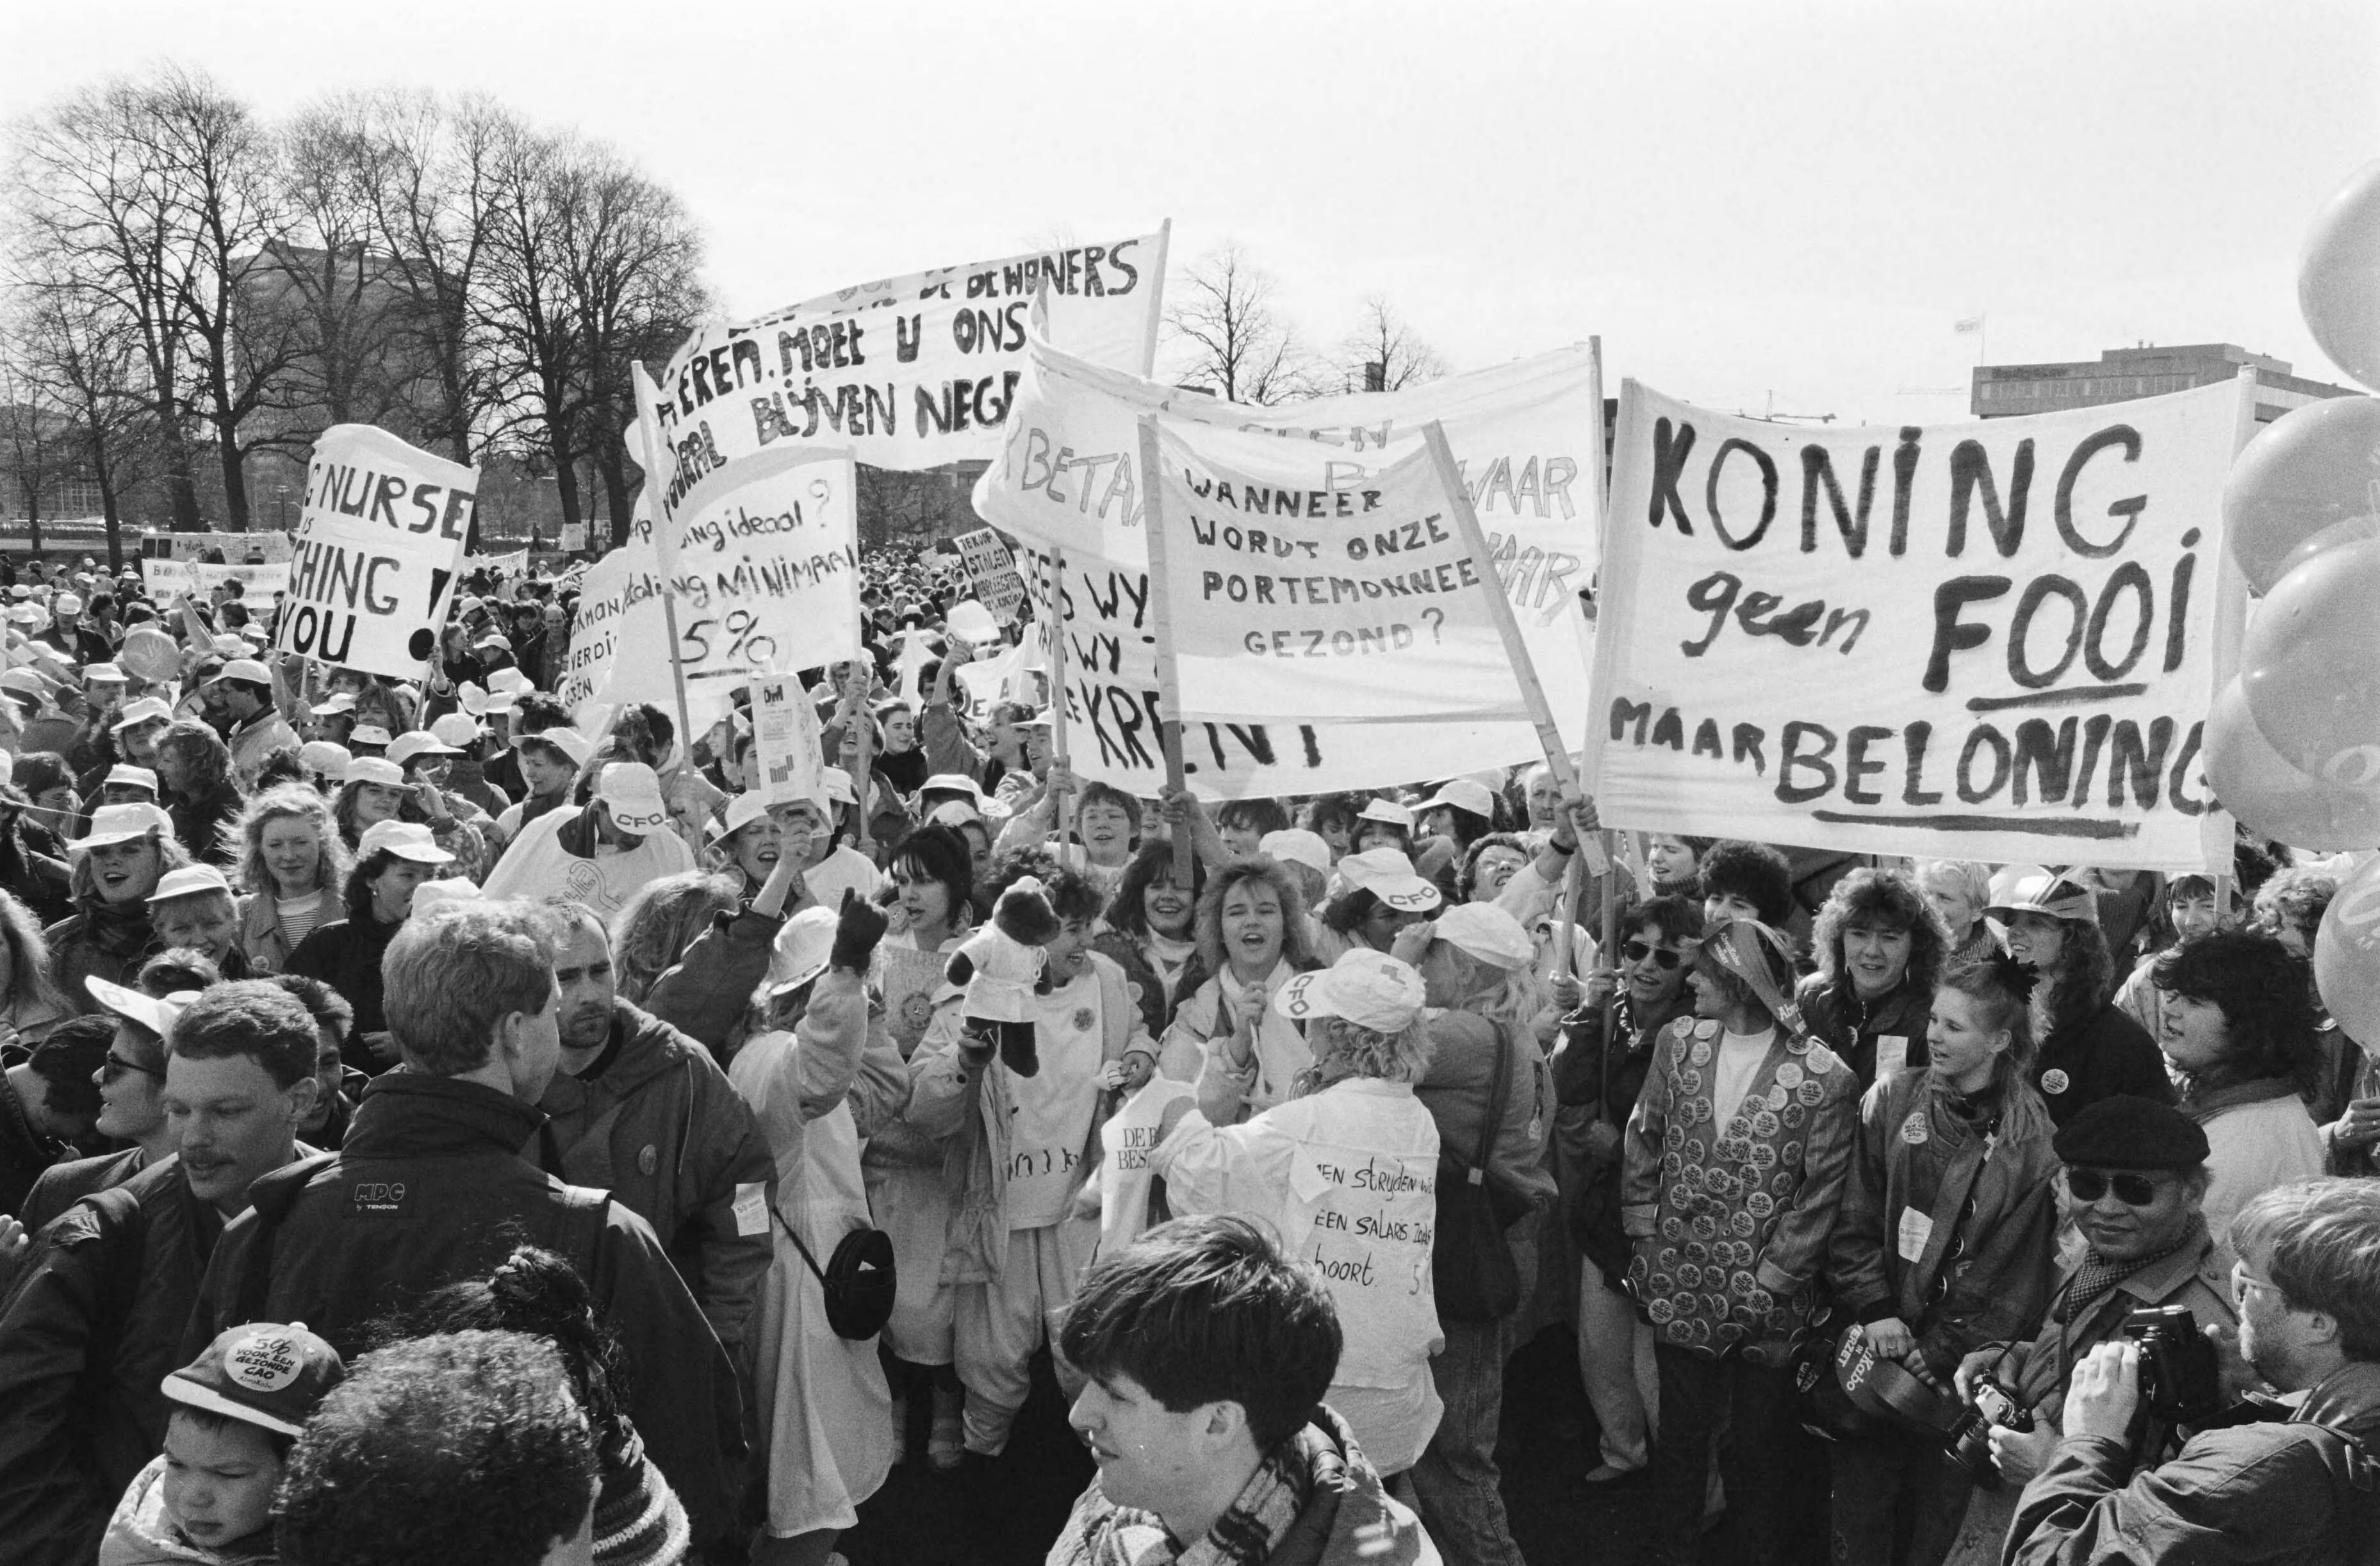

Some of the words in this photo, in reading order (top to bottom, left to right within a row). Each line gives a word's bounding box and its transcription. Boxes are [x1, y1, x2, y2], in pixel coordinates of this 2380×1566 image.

[896, 316, 921, 363] U
[953, 300, 1030, 355] ONS
[319, 462, 475, 542] NURSE
[1185, 468, 1383, 518] WANNEER
[1346, 512, 1450, 560] ONZE
[1202, 557, 1481, 605] PORTEMONNEE
[277, 599, 357, 664] YOU
[665, 609, 777, 665] 5%
[1679, 570, 1872, 657] geen
[1610, 695, 1766, 776] MAAR
[616, 812, 664, 828] CFO
[1388, 886, 1438, 905] CFO
[1287, 974, 1315, 1016] CFO
[1124, 1127, 1145, 1148] DE
[234, 1355, 291, 1375] GEZONDE
[236, 1348, 270, 1359] VOOR
[272, 1354, 295, 1367] EEN
[253, 1337, 292, 1355] 5%
[244, 1366, 275, 1380] CAO
